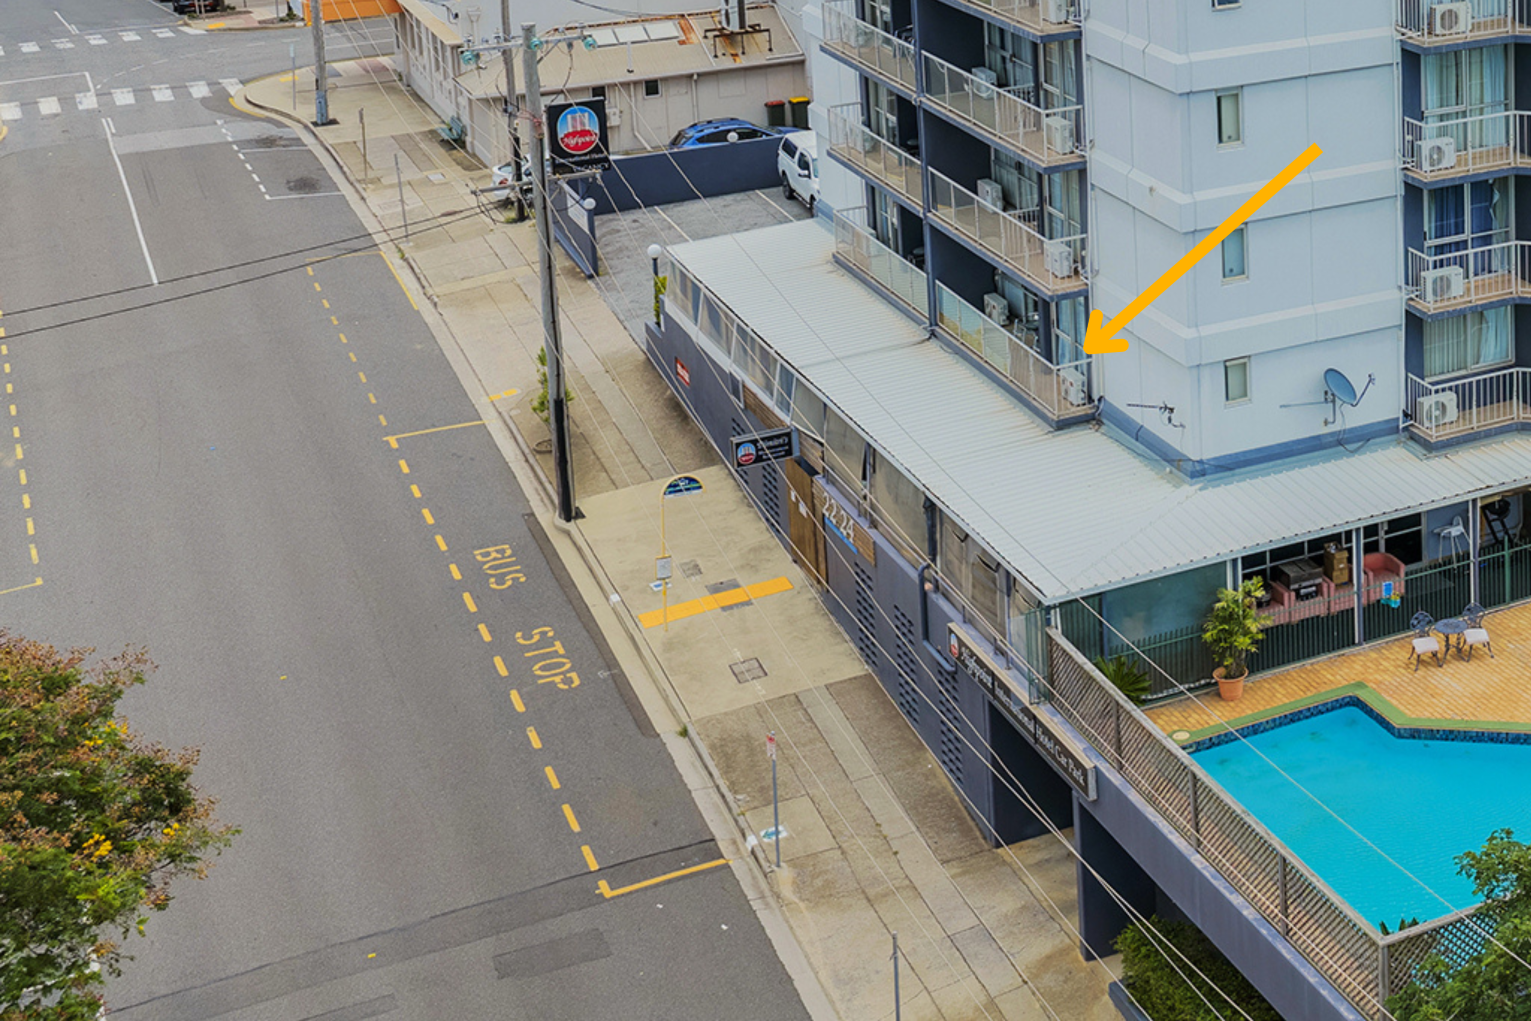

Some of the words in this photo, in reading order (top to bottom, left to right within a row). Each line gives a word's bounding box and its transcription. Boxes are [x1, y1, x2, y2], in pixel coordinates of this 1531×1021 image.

[473, 544, 527, 589] BUS
[515, 626, 581, 689] STOP
[1055, 745, 1067, 767] Car
[1069, 758, 1085, 786] Park
